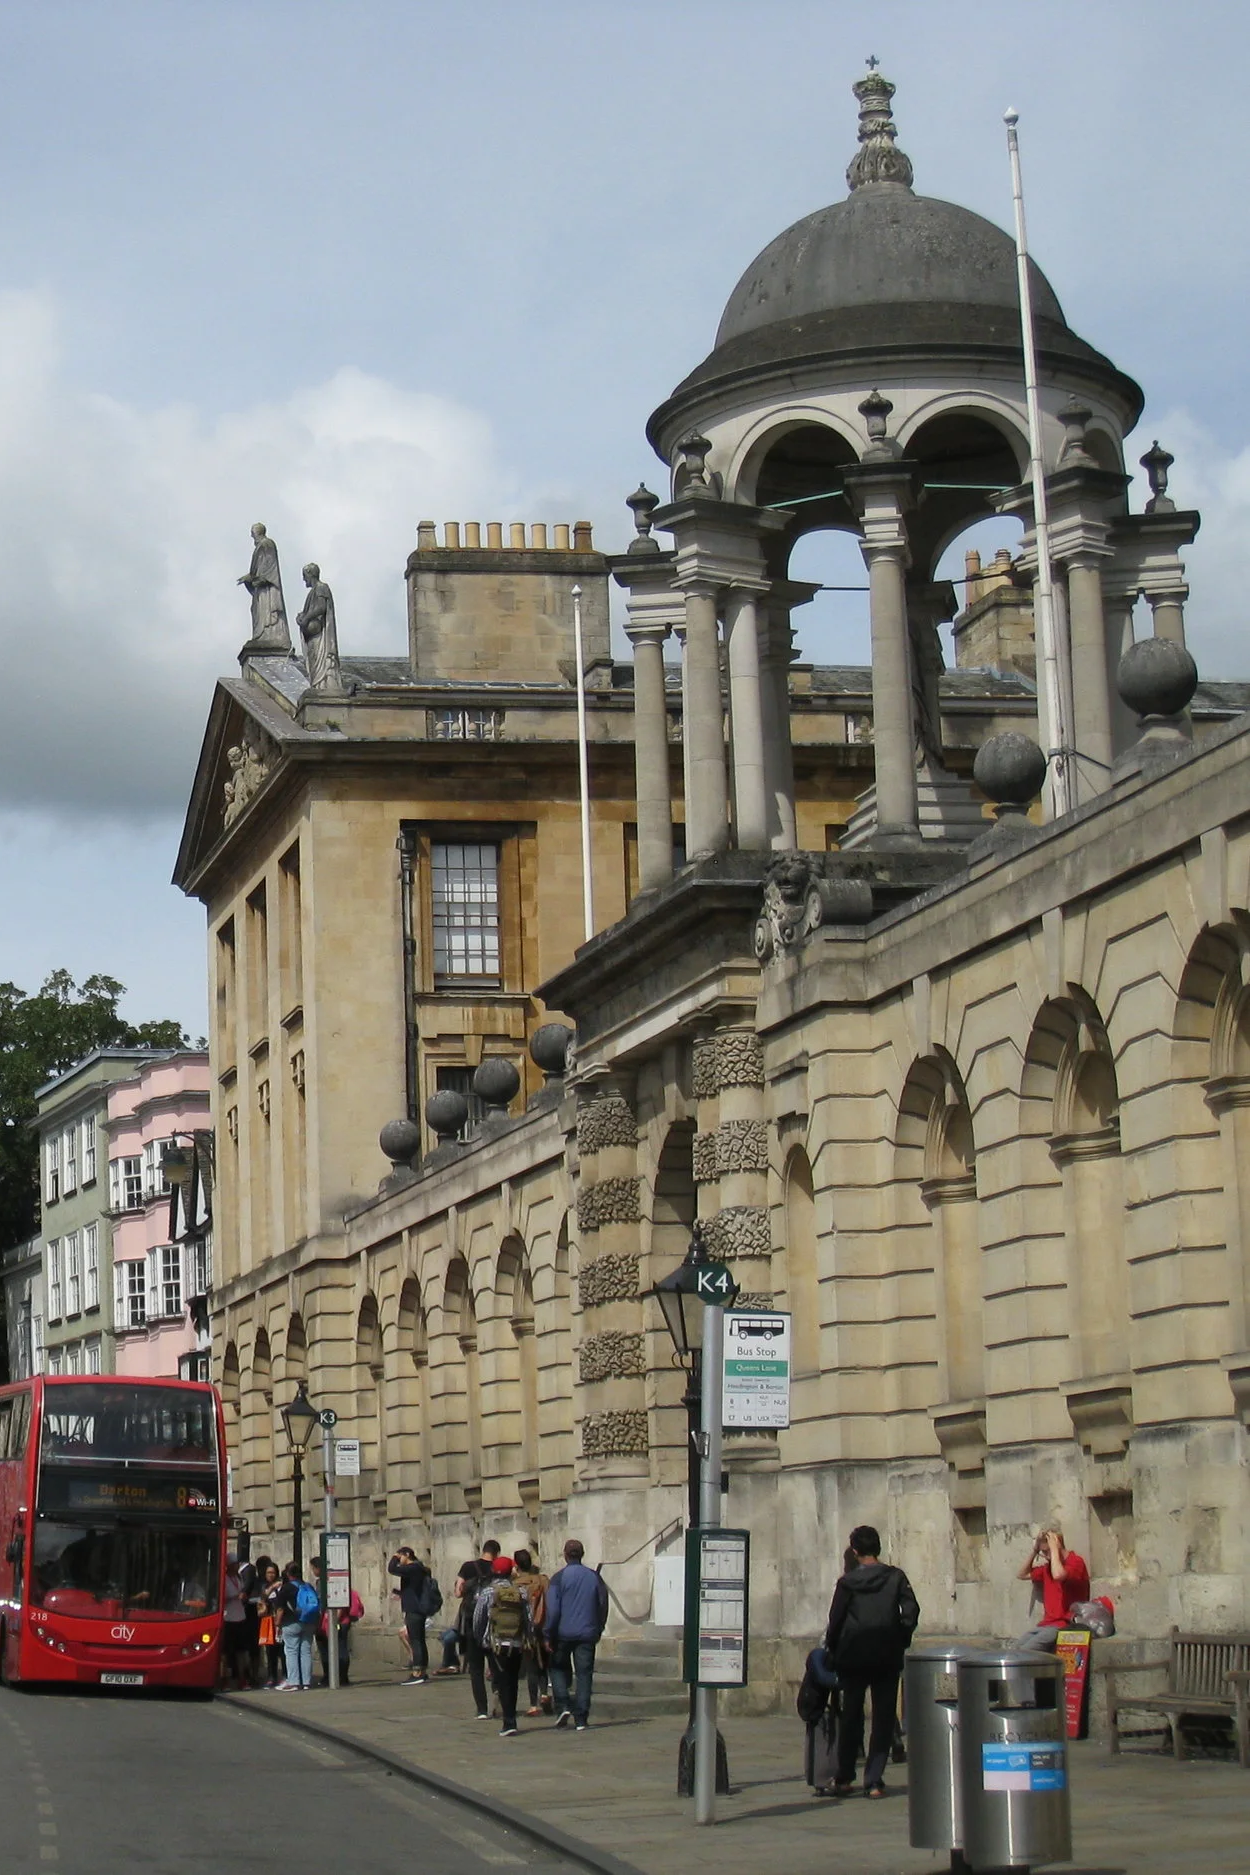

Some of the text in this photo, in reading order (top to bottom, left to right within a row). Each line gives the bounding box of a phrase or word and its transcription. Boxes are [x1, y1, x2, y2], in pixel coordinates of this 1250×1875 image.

[697, 1271, 729, 1293] K4
[737, 1346, 777, 1358] Bus Stop
[735, 1364, 760, 1372] Queens
[320, 1412, 335, 1424] K3
[100, 1484, 147, 1497] Barton
[196, 1497, 216, 1507] Wi-Fi
[30, 1612, 48, 1621] 218
[110, 1624, 135, 1642] city
